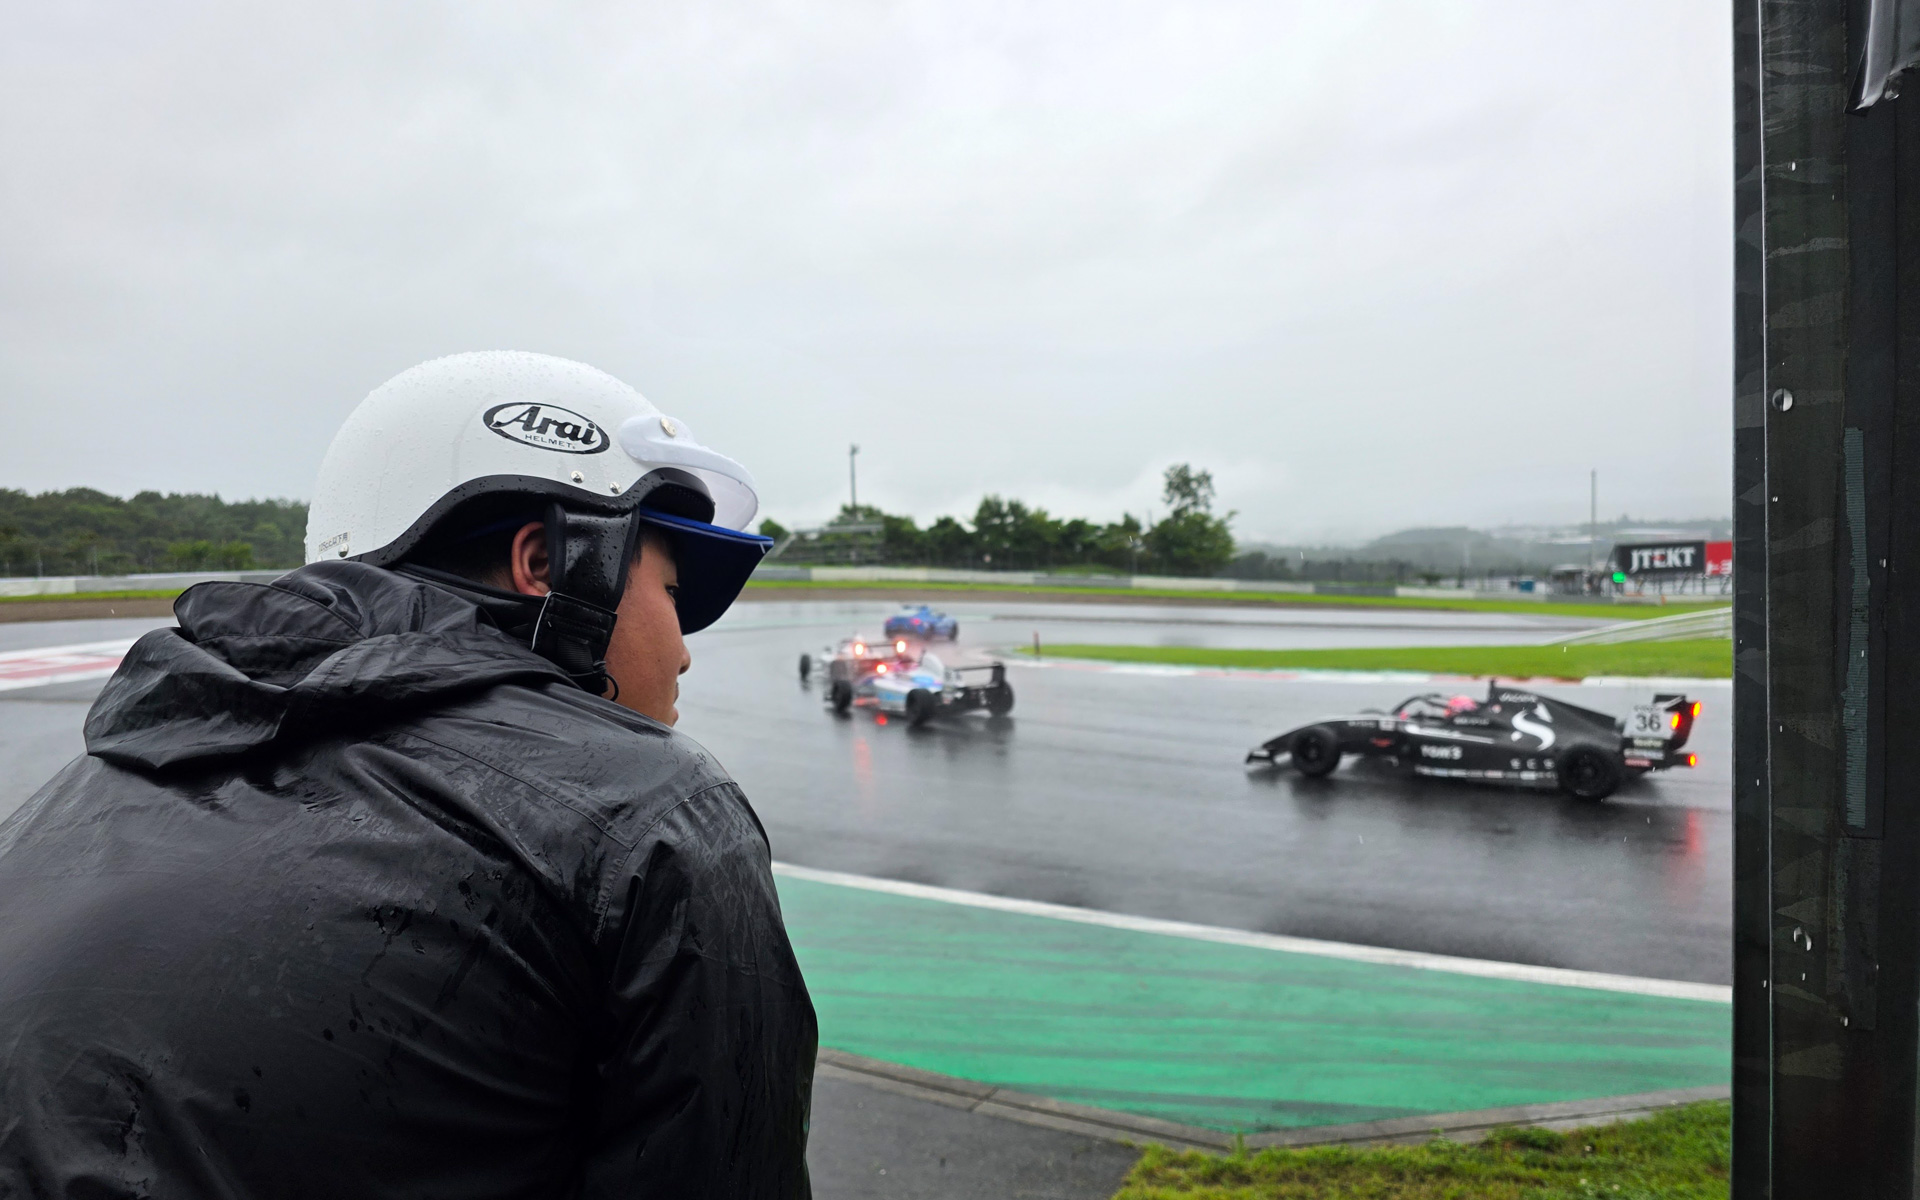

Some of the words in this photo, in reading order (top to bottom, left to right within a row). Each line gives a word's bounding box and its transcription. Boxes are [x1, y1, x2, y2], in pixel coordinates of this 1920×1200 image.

[491, 405, 597, 446] Arai
[524, 434, 573, 449] HELMET
[1628, 546, 1696, 574] JTEKT
[1635, 713, 1661, 732] 36
